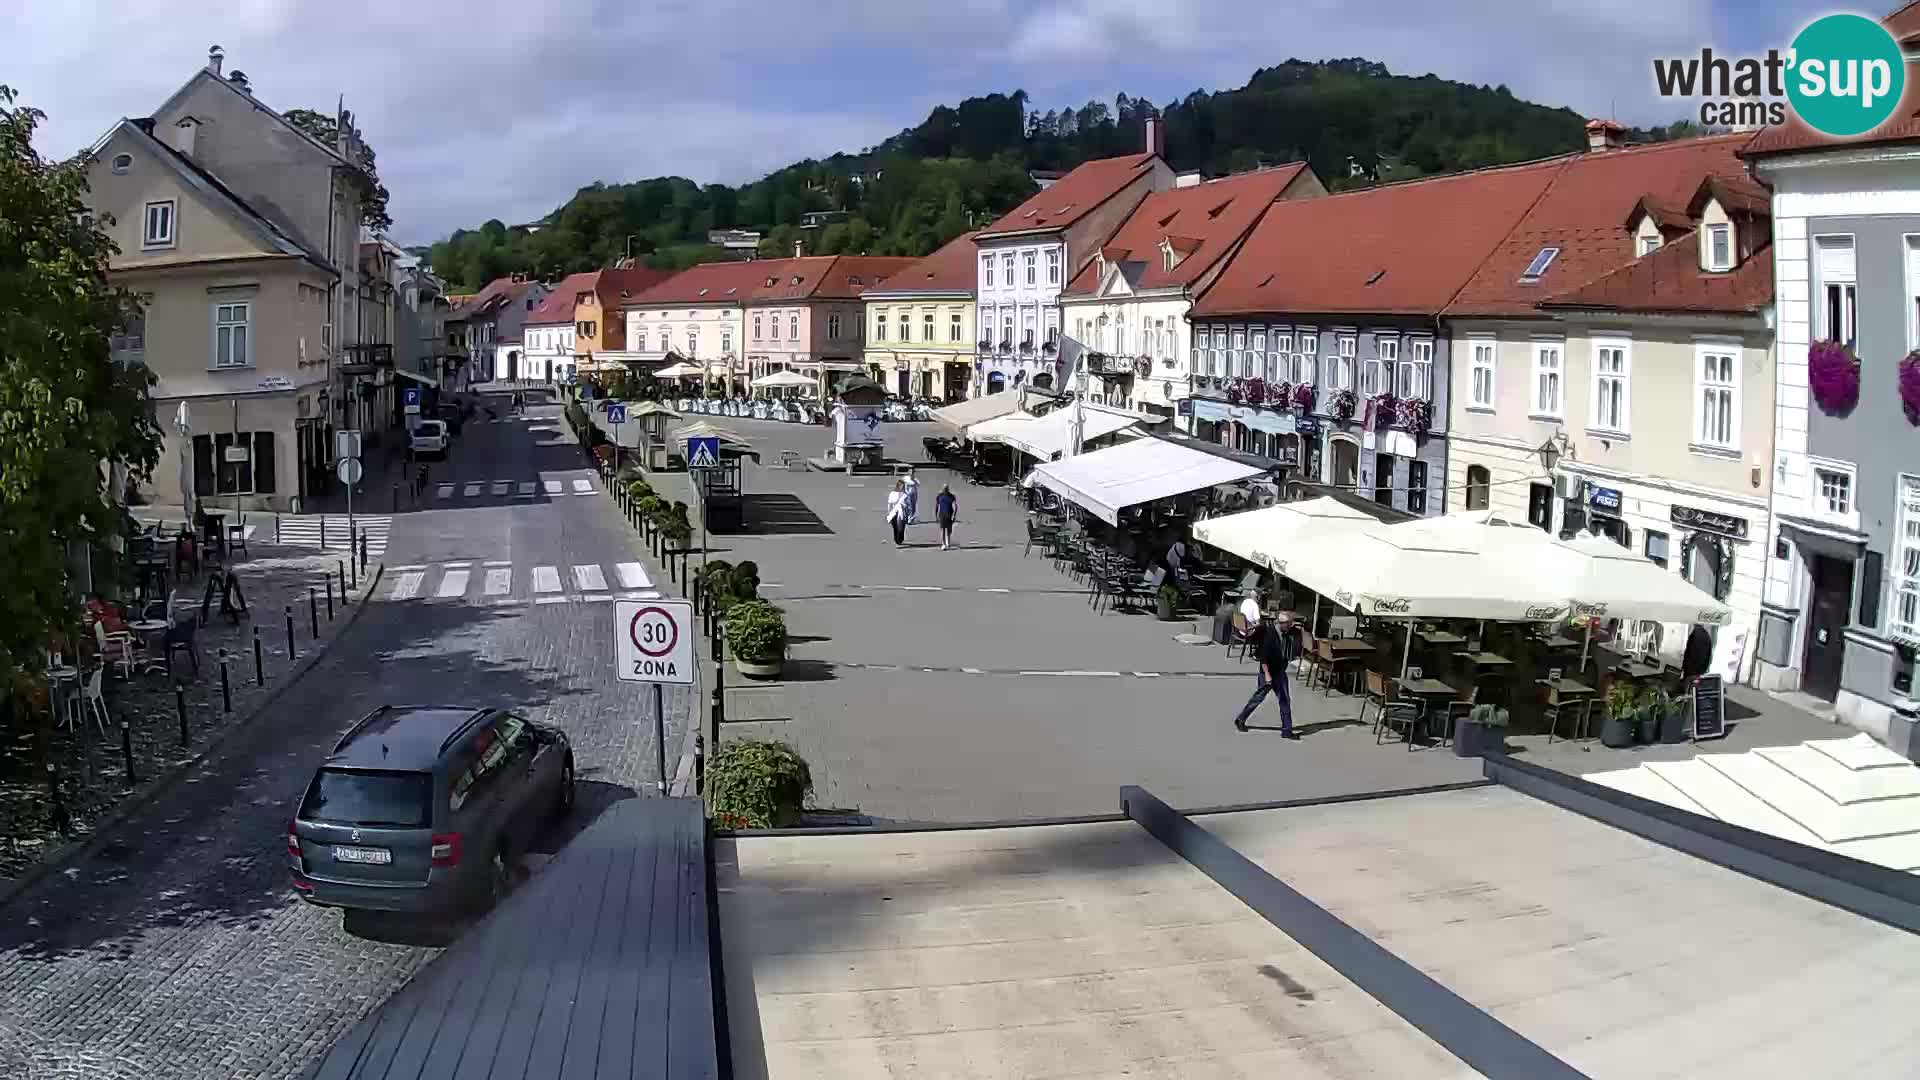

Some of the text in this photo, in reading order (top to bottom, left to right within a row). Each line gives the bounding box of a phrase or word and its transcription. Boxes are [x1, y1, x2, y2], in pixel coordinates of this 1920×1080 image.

[409, 391, 415, 402] P
[643, 623, 666, 643] 30
[633, 660, 677, 676] ZONA
